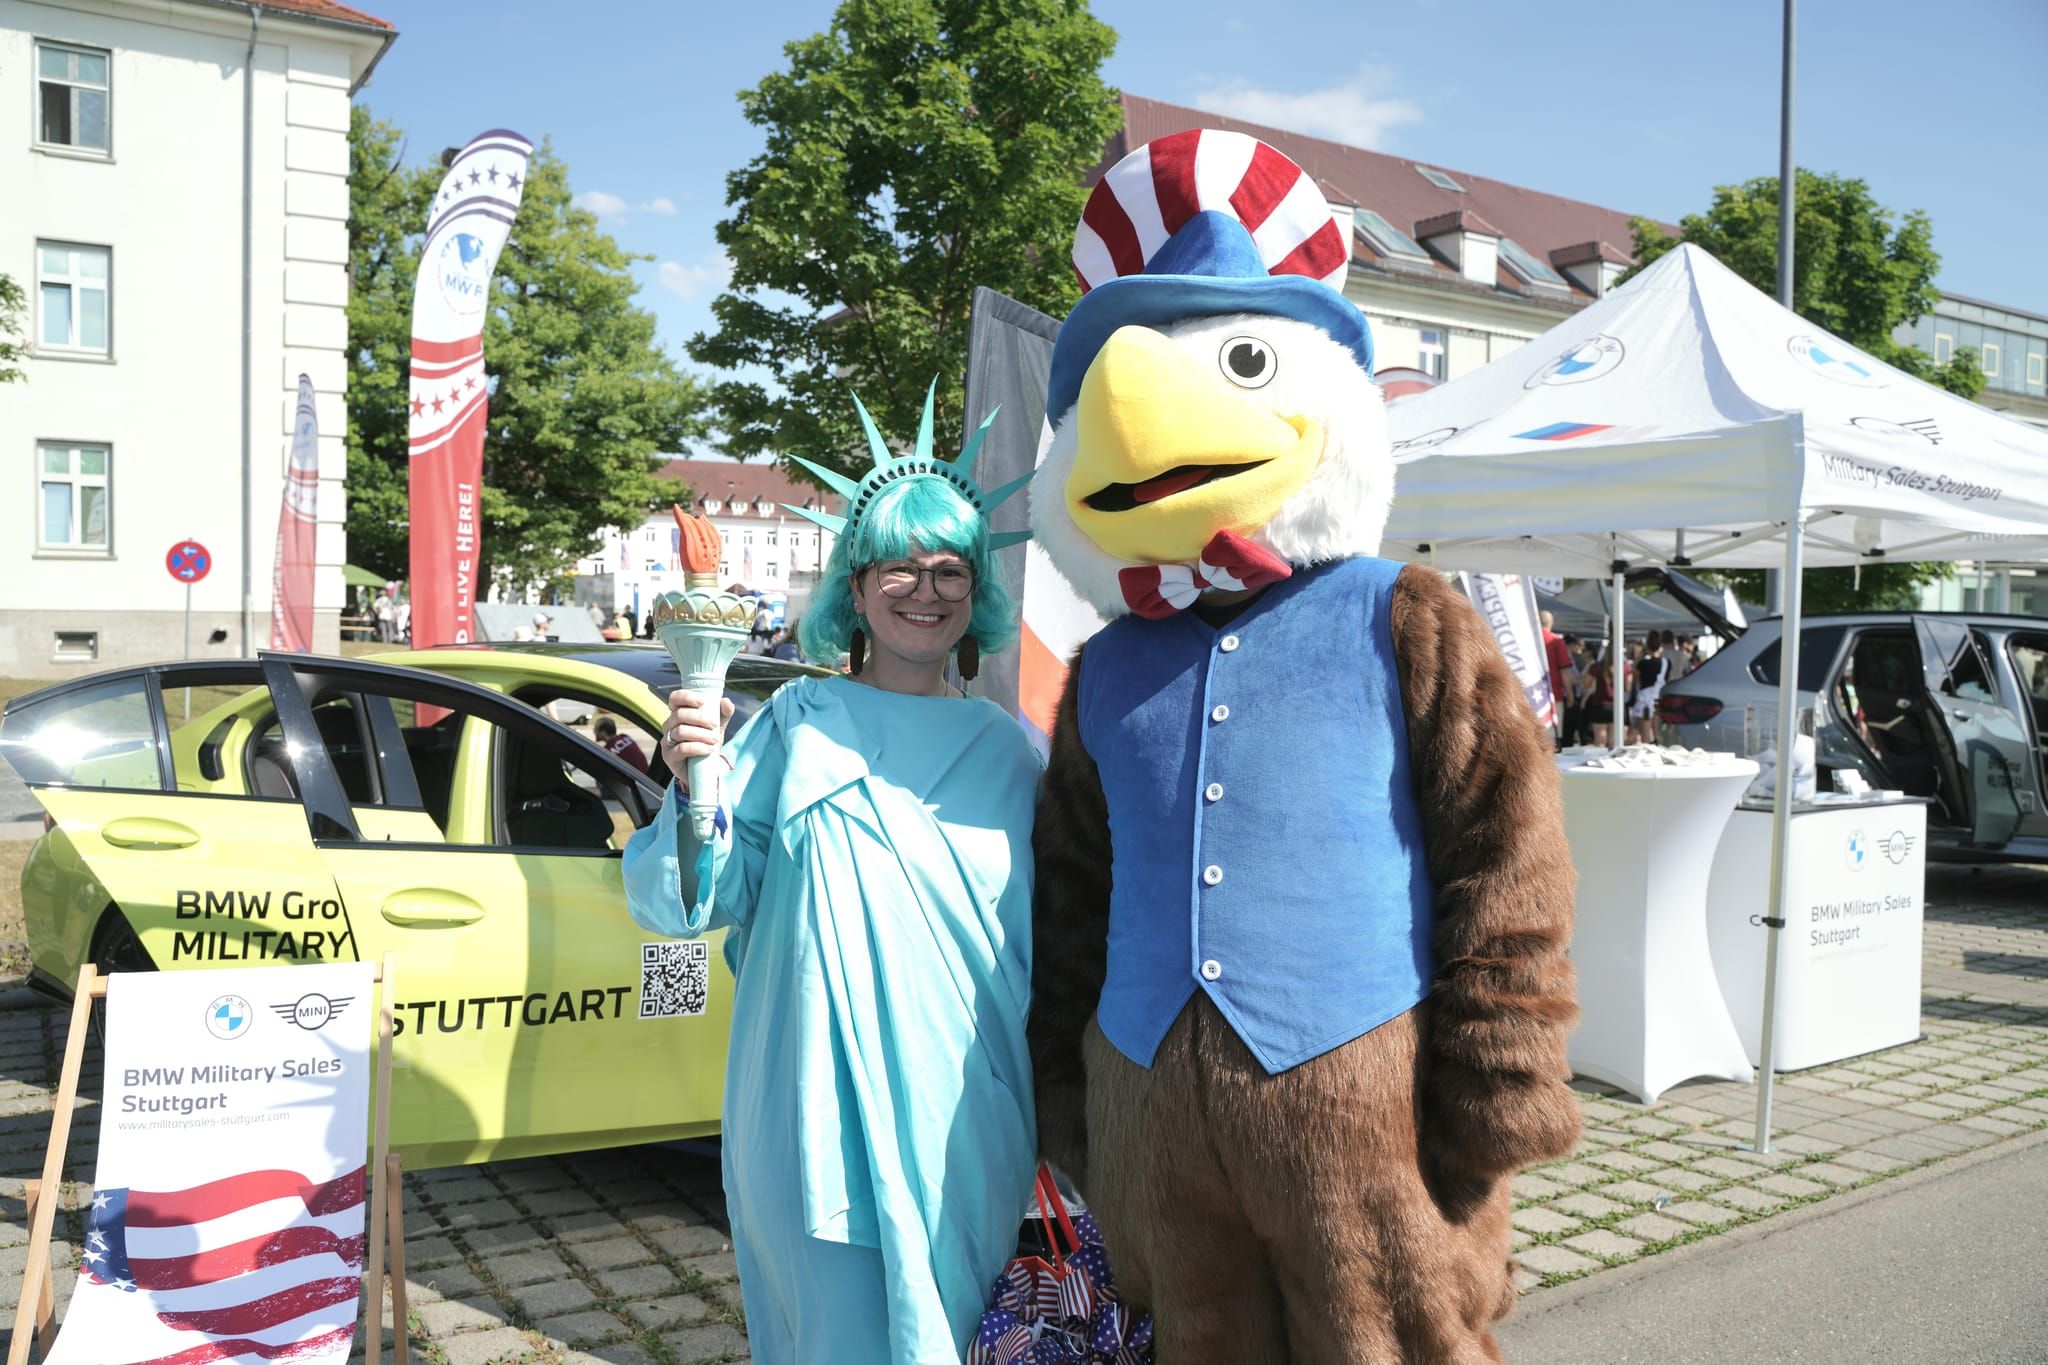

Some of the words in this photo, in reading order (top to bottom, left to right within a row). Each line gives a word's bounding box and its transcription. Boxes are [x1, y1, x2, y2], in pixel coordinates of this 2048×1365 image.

[1822, 455, 1883, 488] Military
[1884, 466, 1931, 490] Sales
[456, 483, 473, 552] HERE!
[457, 559, 470, 607] LIVE
[176, 890, 272, 920] BMW
[1811, 904, 1841, 922] BMW
[1843, 899, 1881, 918] Military
[1884, 895, 1911, 911] Sales
[172, 931, 350, 961] MILITARY
[1810, 926, 1860, 946] Stuttgart
[298, 1006, 327, 1018] MINI
[123, 1067, 185, 1087] BMW
[191, 1065, 276, 1084] Military
[282, 1057, 342, 1079] Sales
[121, 1093, 228, 1116] Stuttgart
[118, 1111, 290, 1131] www.militarysales-stuttgart.com
